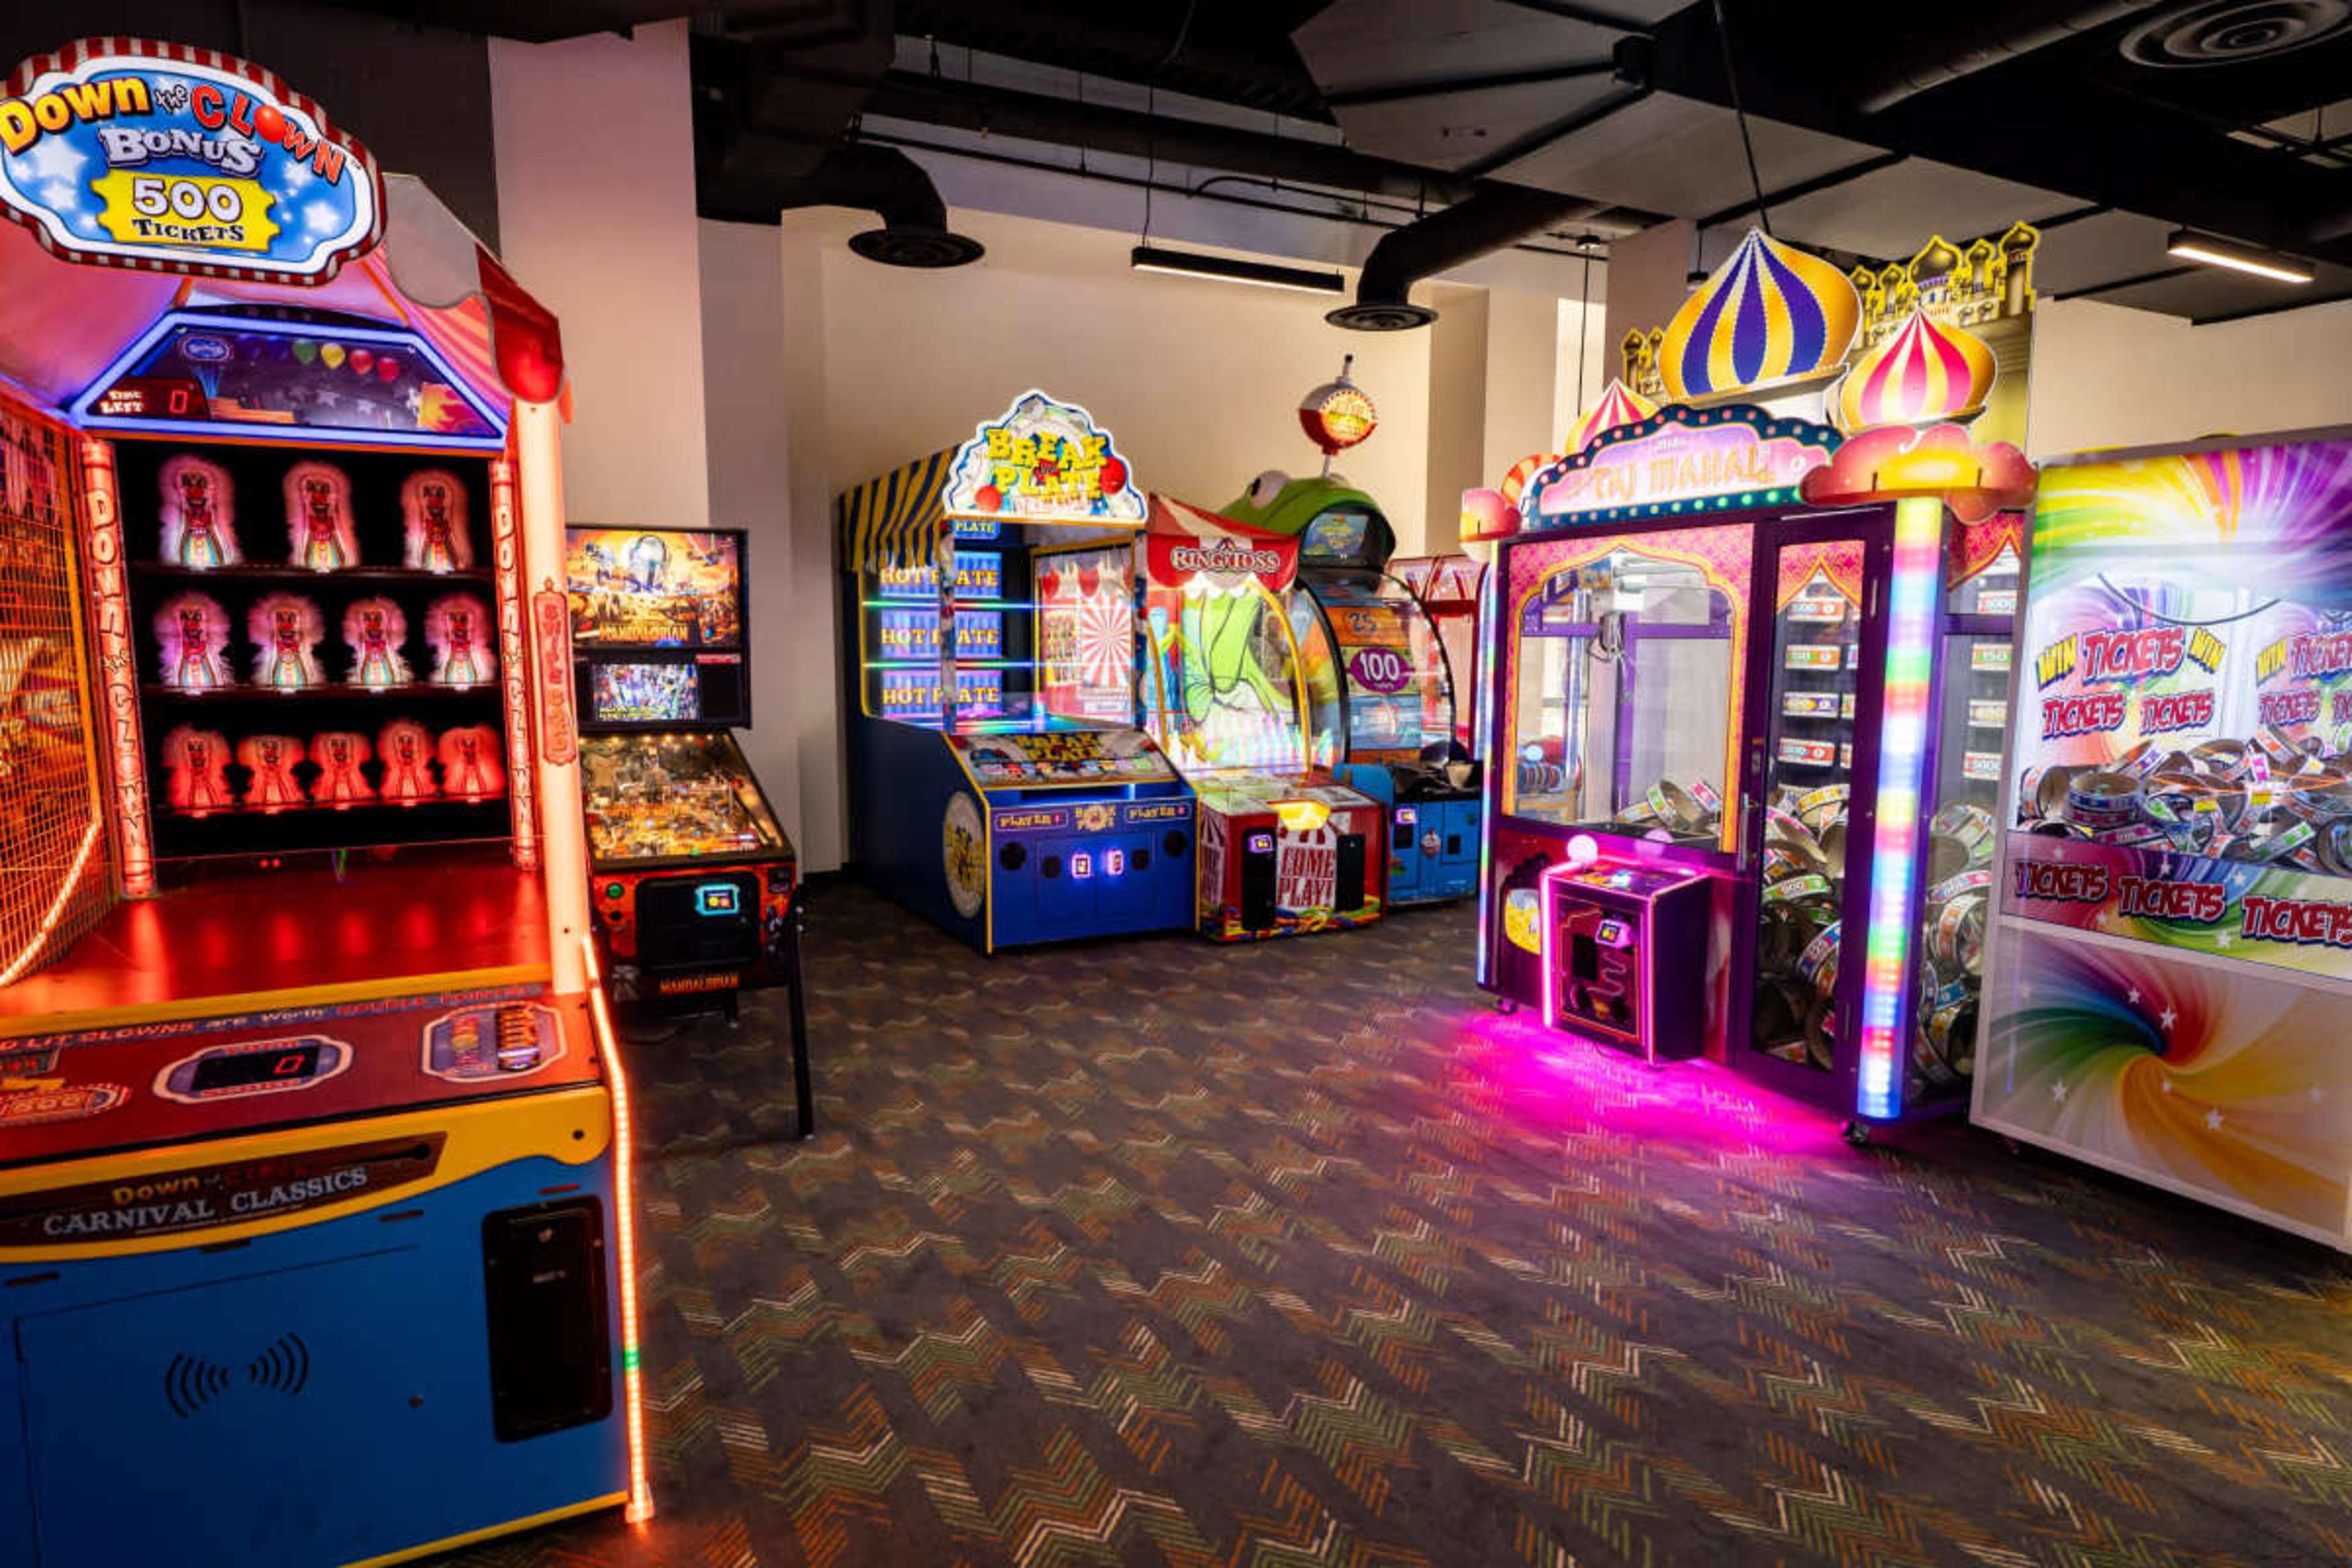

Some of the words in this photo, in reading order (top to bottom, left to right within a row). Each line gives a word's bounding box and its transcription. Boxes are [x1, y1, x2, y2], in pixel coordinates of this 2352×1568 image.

[154, 84, 188, 115] the
[98, 127, 263, 179] BONUS
[132, 178, 243, 223] 500
[132, 219, 245, 243] TICKETS
[986, 428, 1107, 469] BREAK
[992, 466, 1102, 505] PLATE
[1171, 547, 1225, 571] RING
[1227, 550, 1280, 573] TOSS
[880, 568, 924, 585] HOT
[881, 628, 925, 646] HOT
[1360, 652, 1400, 680] 100
[2037, 634, 2078, 691] WIN
[2082, 626, 2187, 685] TICKETS
[2187, 627, 2226, 674] WIN
[883, 688, 927, 705] HOT
[2041, 692, 2128, 740] TICKETS
[2141, 688, 2216, 734] TICKETS
[1281, 846, 1336, 878] COME
[1276, 878, 1333, 907] PLAY!
[2015, 860, 2109, 903] TICKETS
[2119, 876, 2226, 922] TICKETS
[43, 1198, 216, 1236] CARNIVAL
[230, 1166, 369, 1213] CLASSICS
